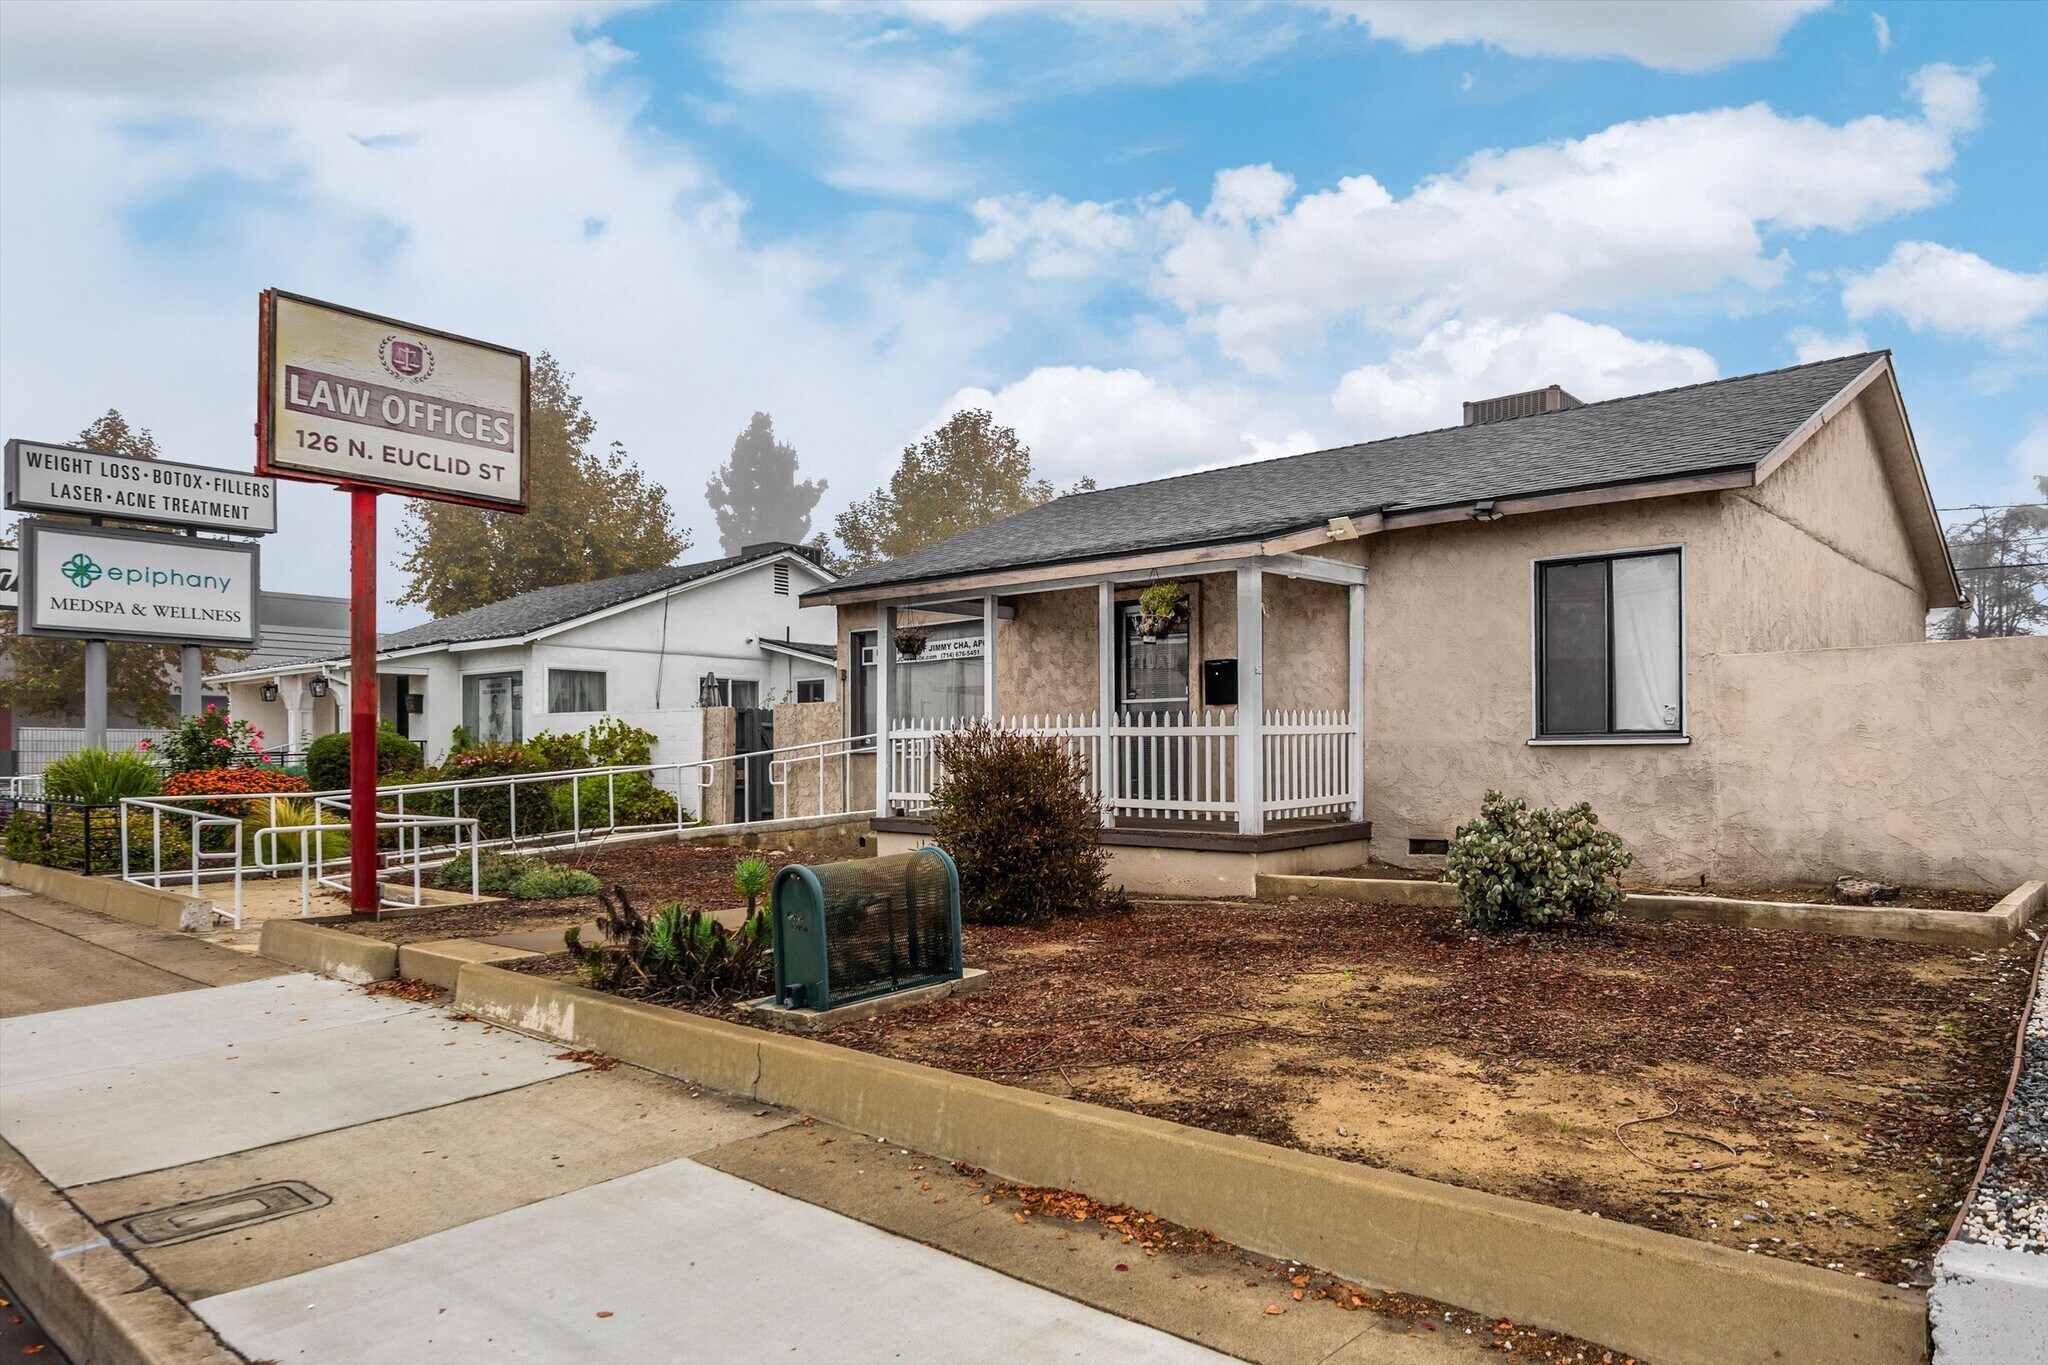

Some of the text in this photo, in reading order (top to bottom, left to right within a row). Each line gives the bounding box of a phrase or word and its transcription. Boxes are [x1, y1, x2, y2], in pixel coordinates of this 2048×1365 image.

[289, 373, 510, 446] LAW OFFICES
[26, 451, 93, 475] WEIGHT
[295, 429, 506, 482] 126 N. EUCLID ST
[162, 495, 250, 521] TREATMENT
[107, 566, 232, 594] epiphany
[50, 597, 242, 623] MEDSPA & WELLNESS
[929, 643, 952, 651] JIMMY
[973, 639, 984, 648] AP
